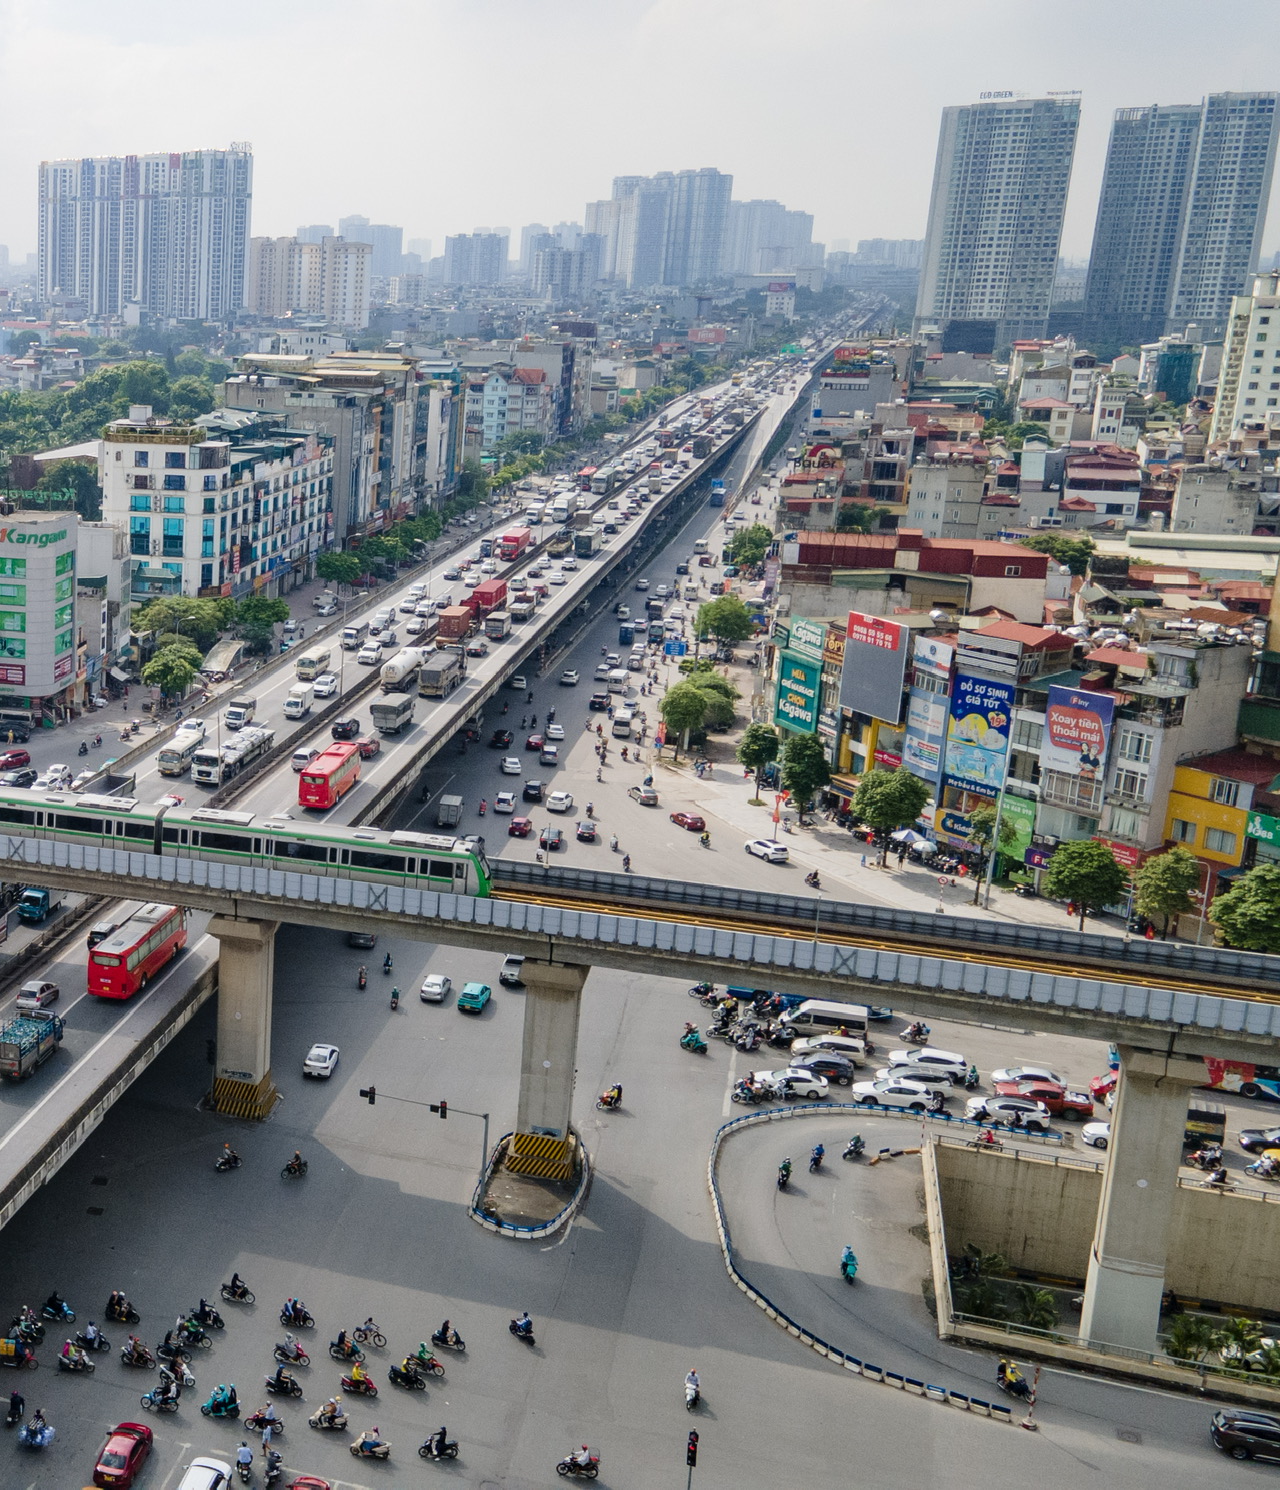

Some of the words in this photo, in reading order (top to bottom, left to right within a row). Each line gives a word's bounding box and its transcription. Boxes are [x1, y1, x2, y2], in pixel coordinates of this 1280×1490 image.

[993, 91, 1013, 99] GREEN
[792, 623, 821, 646] Kagawa
[960, 679, 973, 692] ĐỒ
[974, 685, 986, 694] SƠ
[987, 688, 1008, 699] SINH
[779, 699, 812, 723] Kagawa
[1051, 711, 1077, 727] Xoay
[1078, 718, 1099, 731] tiền
[1080, 730, 1100, 743] mái
